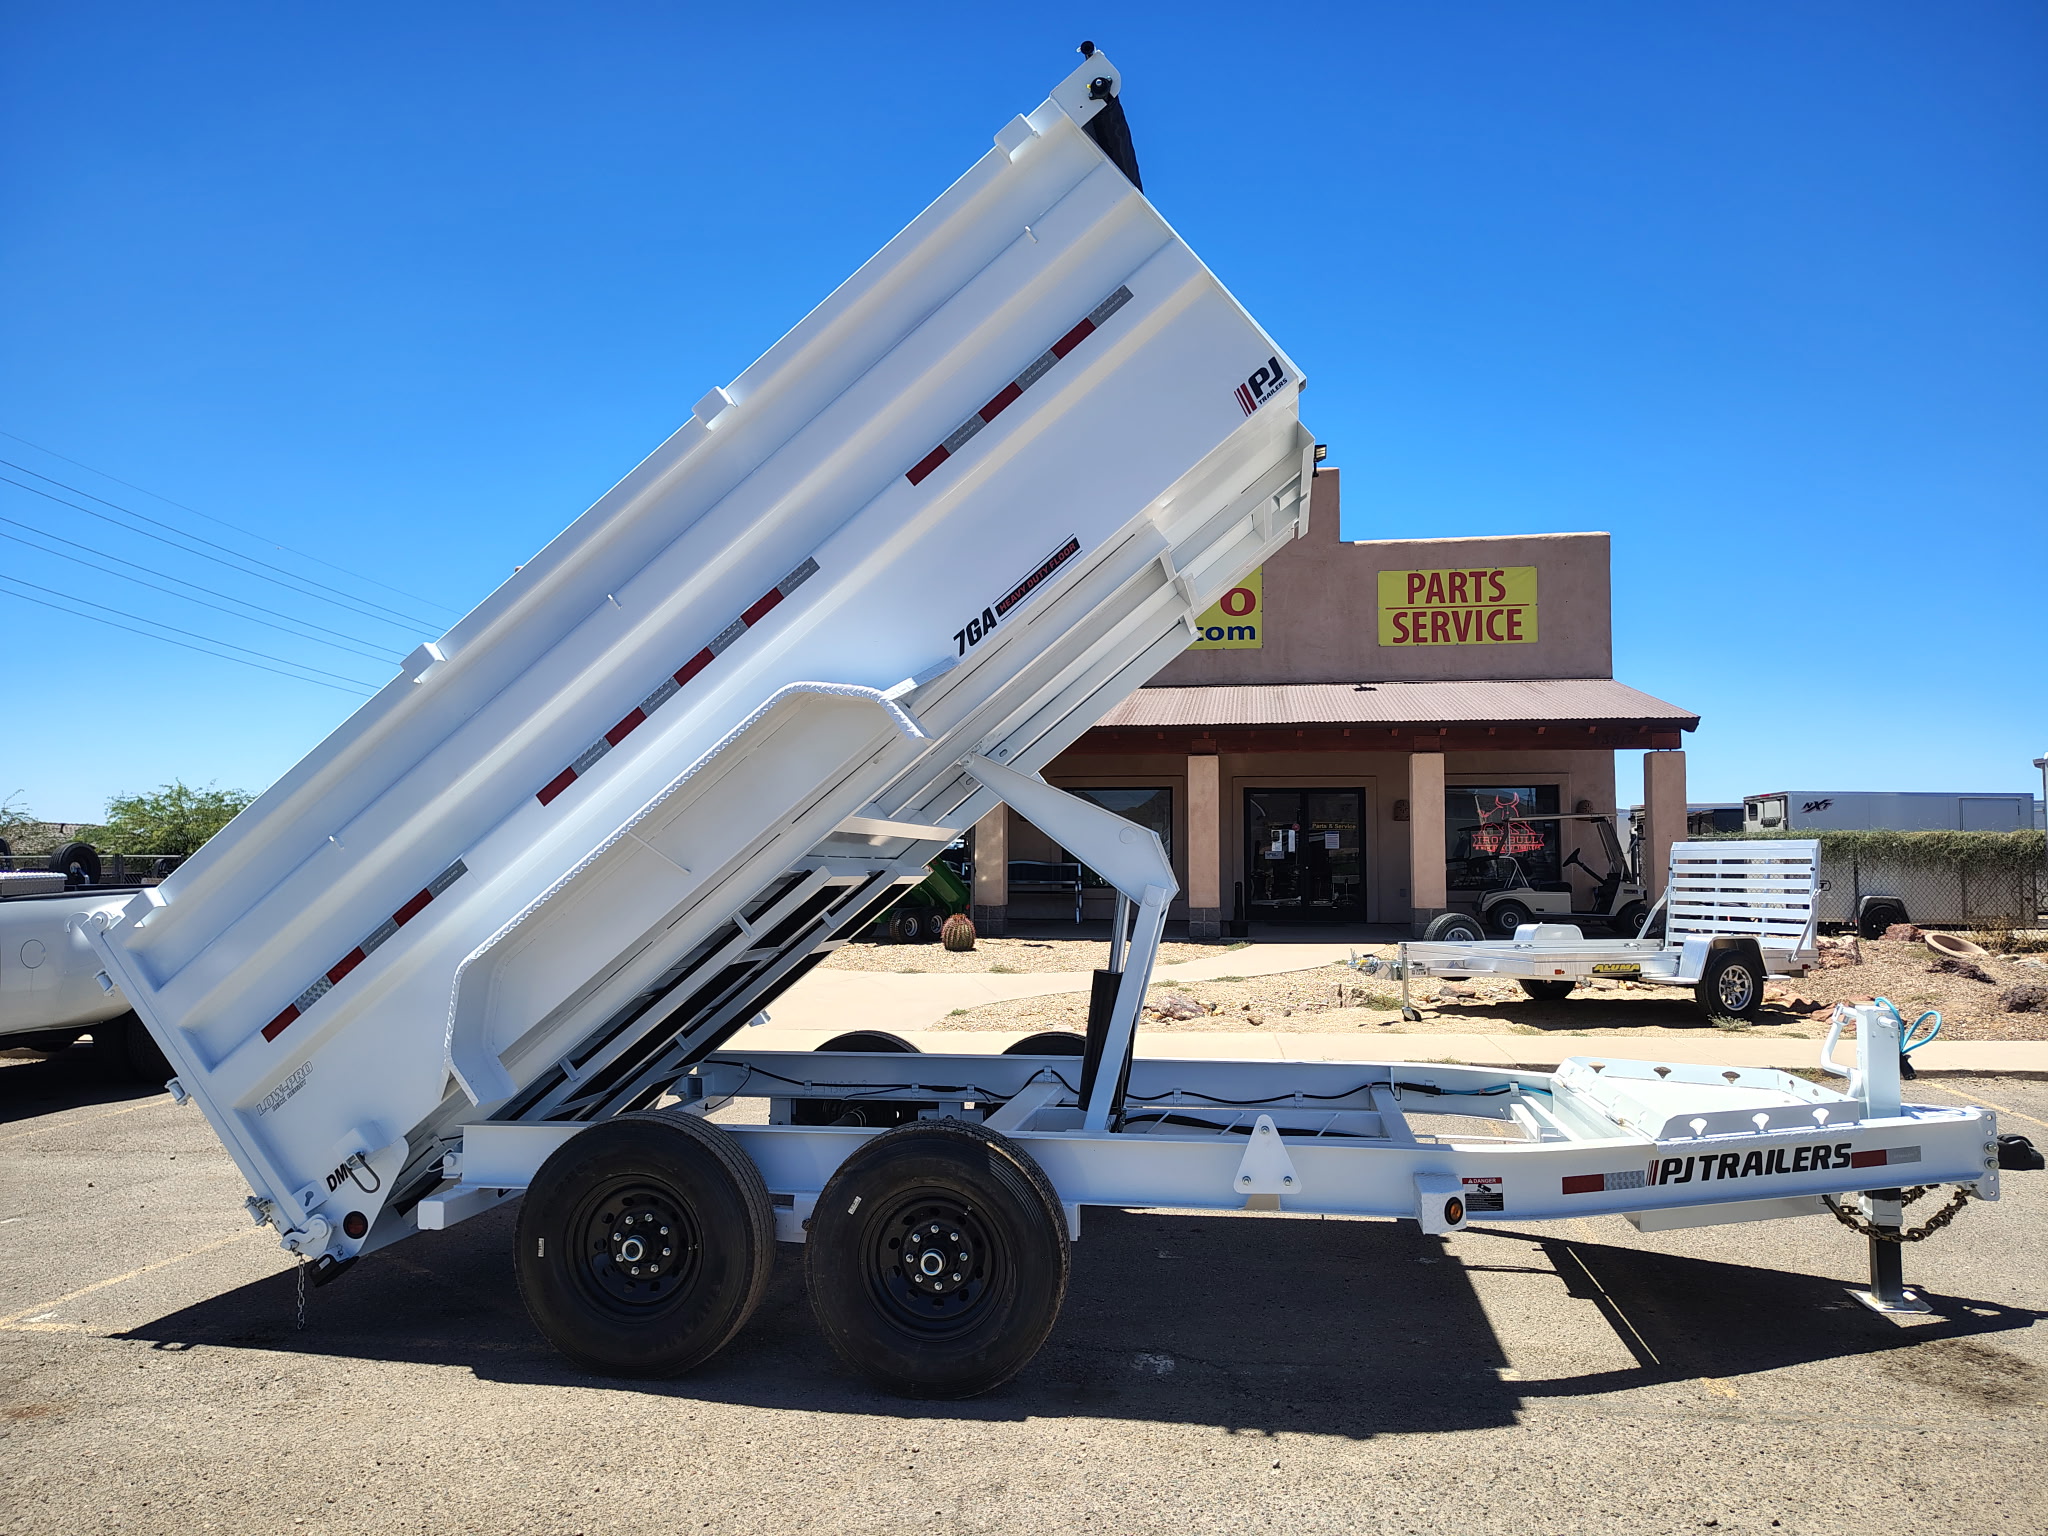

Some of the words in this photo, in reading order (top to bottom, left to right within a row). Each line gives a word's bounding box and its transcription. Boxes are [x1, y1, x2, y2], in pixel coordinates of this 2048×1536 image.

[1248, 356, 1284, 399] PJ
[1258, 378, 1288, 405] TRAILERS
[953, 607, 998, 657] 7GA
[999, 583, 1028, 612] HEAVY
[1026, 565, 1050, 588] DUTY
[1049, 542, 1077, 569] FLOOR
[1406, 570, 1507, 605] PARTS
[1392, 608, 1524, 644] SERVICE
[1593, 963, 1640, 973] ALUMA
[256, 1060, 313, 1116] LOW-PRO
[1658, 1156, 1695, 1186] PJ
[1699, 1142, 1853, 1182] TRAILERS
